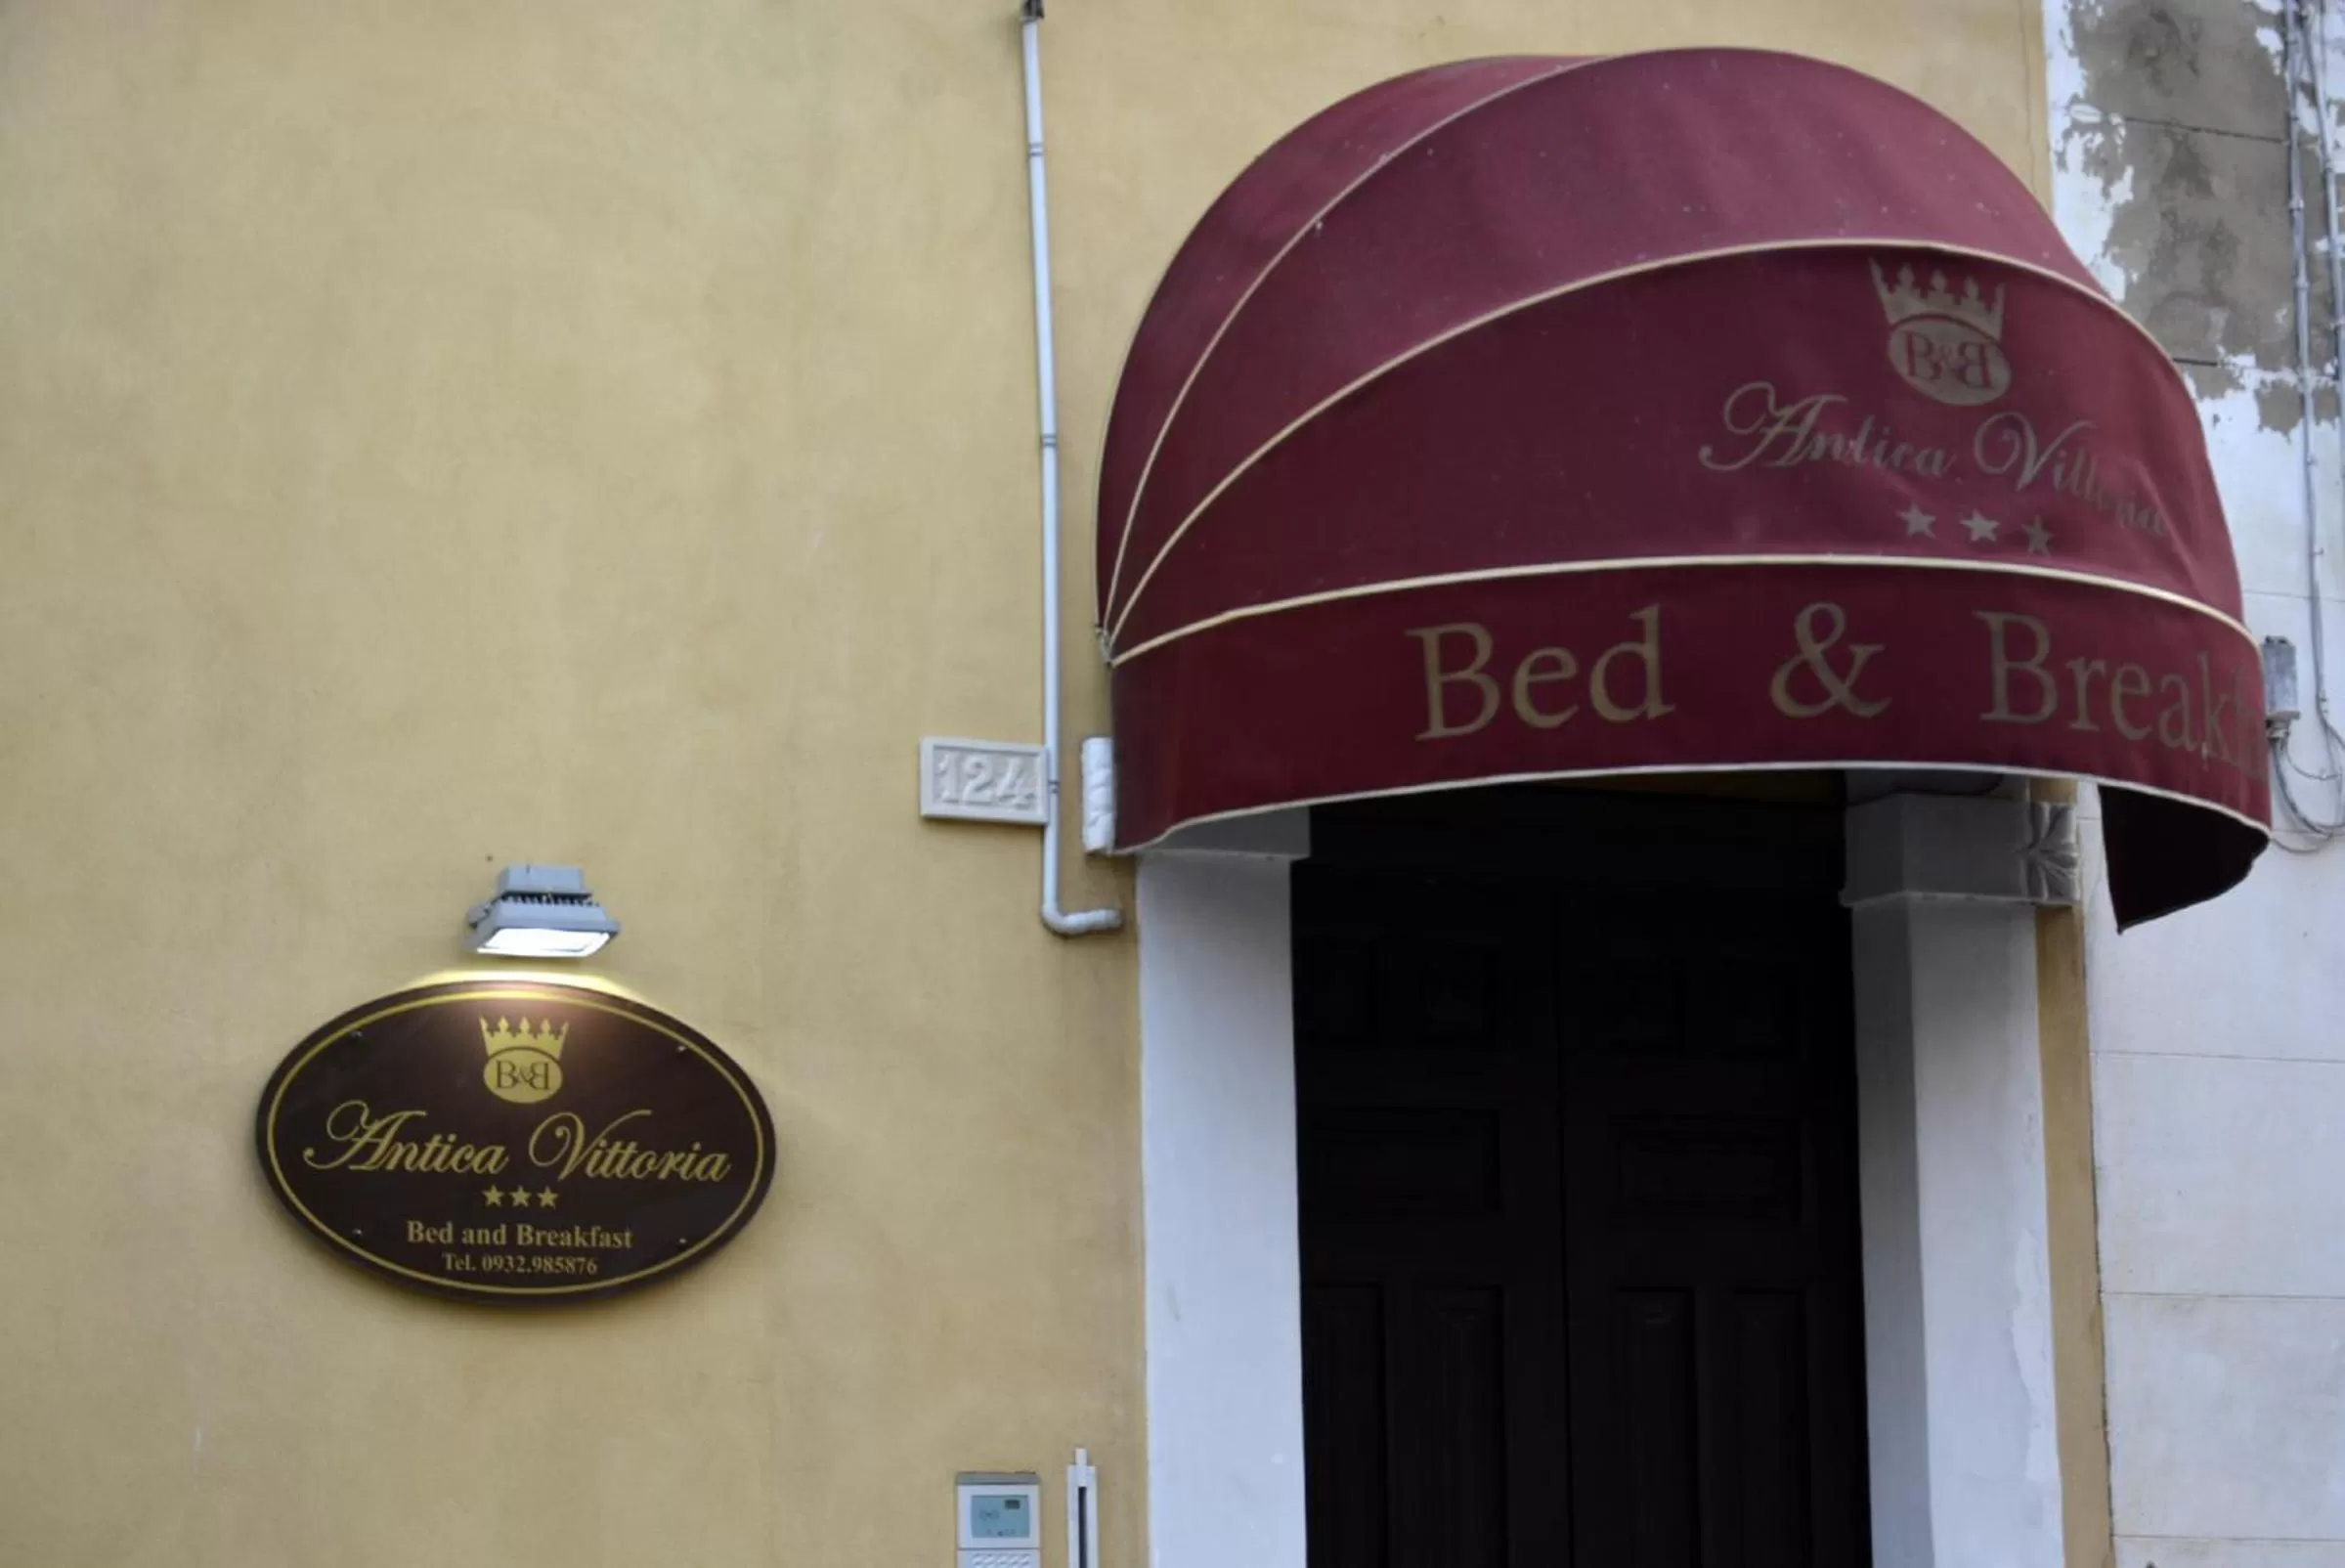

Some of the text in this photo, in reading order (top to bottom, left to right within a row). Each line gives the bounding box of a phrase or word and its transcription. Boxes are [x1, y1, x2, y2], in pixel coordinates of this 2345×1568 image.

[1699, 381, 1955, 476] Antica
[1405, 603, 1675, 742] Bed
[1769, 601, 1892, 719] &
[937, 752, 1032, 809] 124
[495, 1060, 550, 1091] B&B
[303, 1100, 732, 1183] Antica Vittoria
[407, 1220, 634, 1249] Bed and Breakfast
[441, 1253, 598, 1276] Tel. 0932.985876
